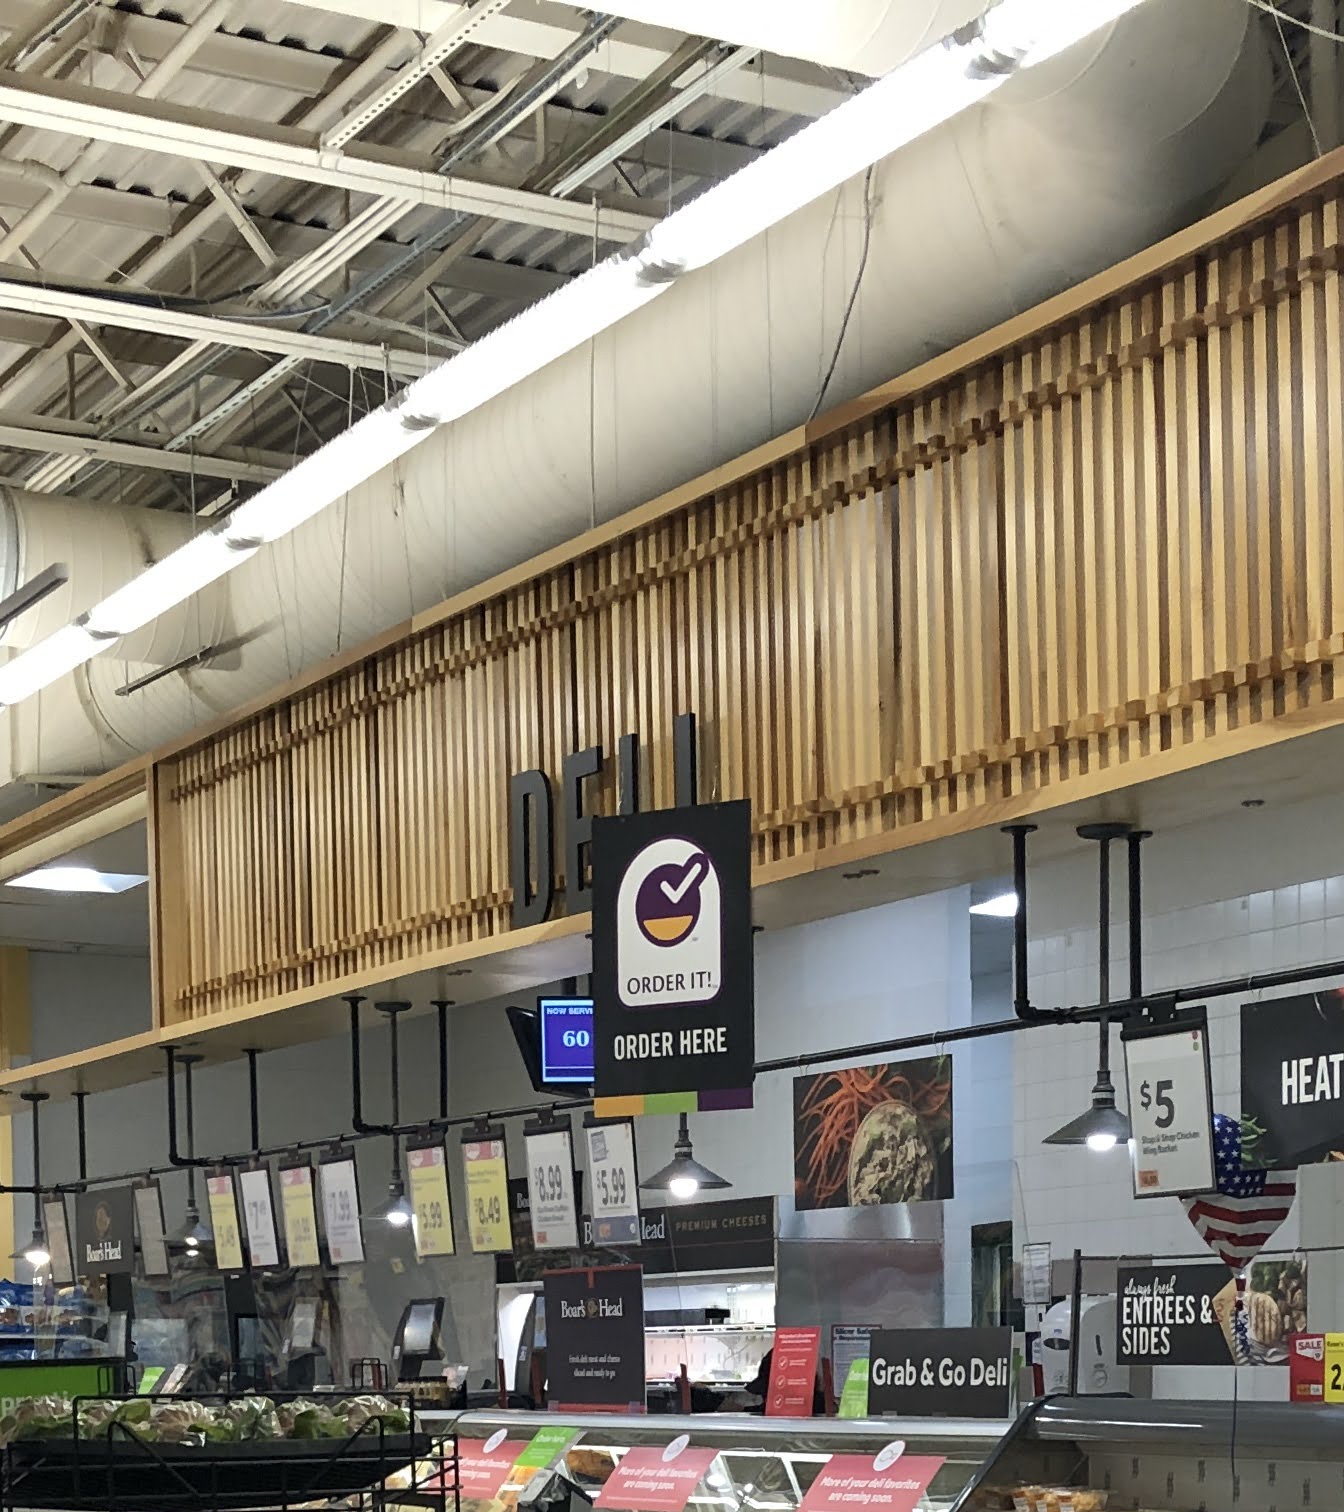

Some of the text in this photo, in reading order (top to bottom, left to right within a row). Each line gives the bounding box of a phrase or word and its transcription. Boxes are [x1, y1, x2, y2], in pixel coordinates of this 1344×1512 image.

[627, 971, 712, 995] ORDER IT!
[546, 1007, 594, 1015] NOW SERVI
[562, 1029, 590, 1047] 60
[613, 1027, 727, 1061] ORDER HERE
[1281, 1053, 1344, 1106] HEAT
[1140, 1079, 1174, 1129] $5
[596, 1166, 627, 1205] $5.99
[675, 1214, 768, 1232] PREMIUM CHEESES
[1124, 1274, 1177, 1300] always fresh
[561, 1297, 623, 1318] Boar's Head
[1122, 1294, 1213, 1325] ENTREES &
[1122, 1326, 1171, 1355] SIDES
[1297, 1339, 1322, 1351] SALE
[872, 1357, 1008, 1387] Grab & Go Deli
[820, 1476, 841, 1487] More
[847, 1479, 868, 1490] your
[868, 1478, 886, 1489] deli
[884, 1478, 921, 1490] favorites
[828, 1491, 893, 1504] are coming soon.
